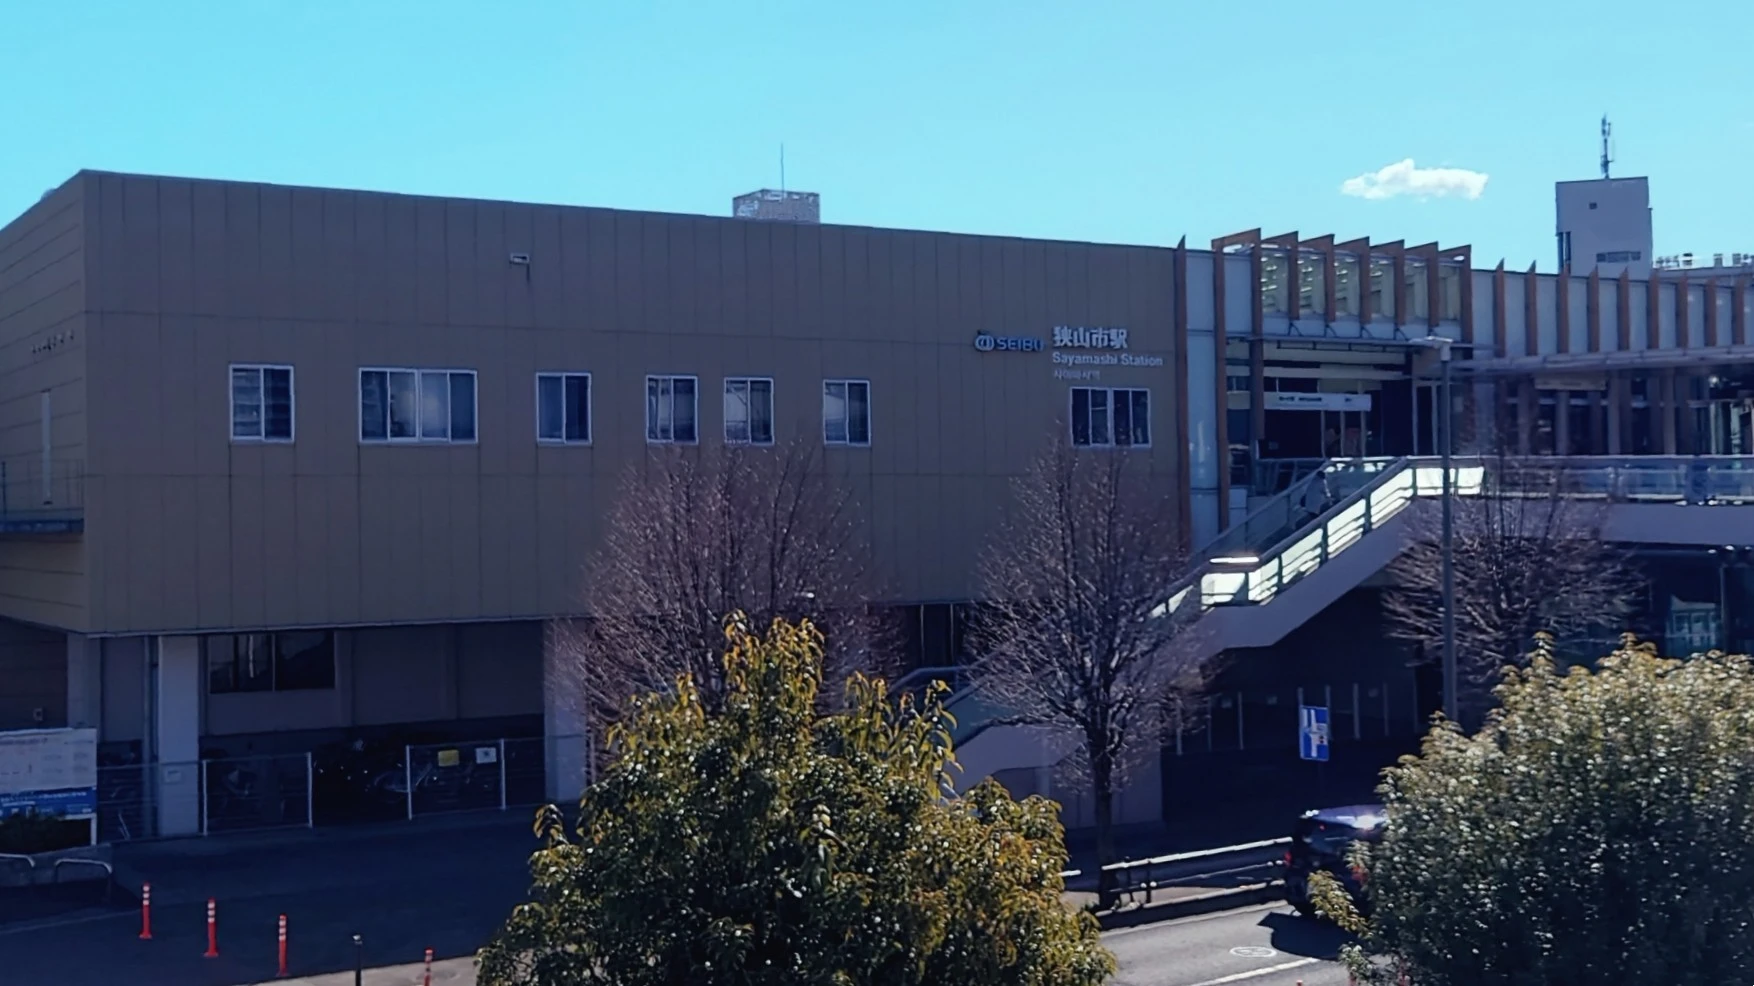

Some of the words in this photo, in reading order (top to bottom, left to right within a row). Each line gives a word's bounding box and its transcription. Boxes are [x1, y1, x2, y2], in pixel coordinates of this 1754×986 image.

[996, 336, 1044, 351] SEIBU
[1053, 326, 1128, 349] 狭山市駅
[1052, 351, 1118, 367] Sayamashi
[1120, 353, 1164, 367] Station
